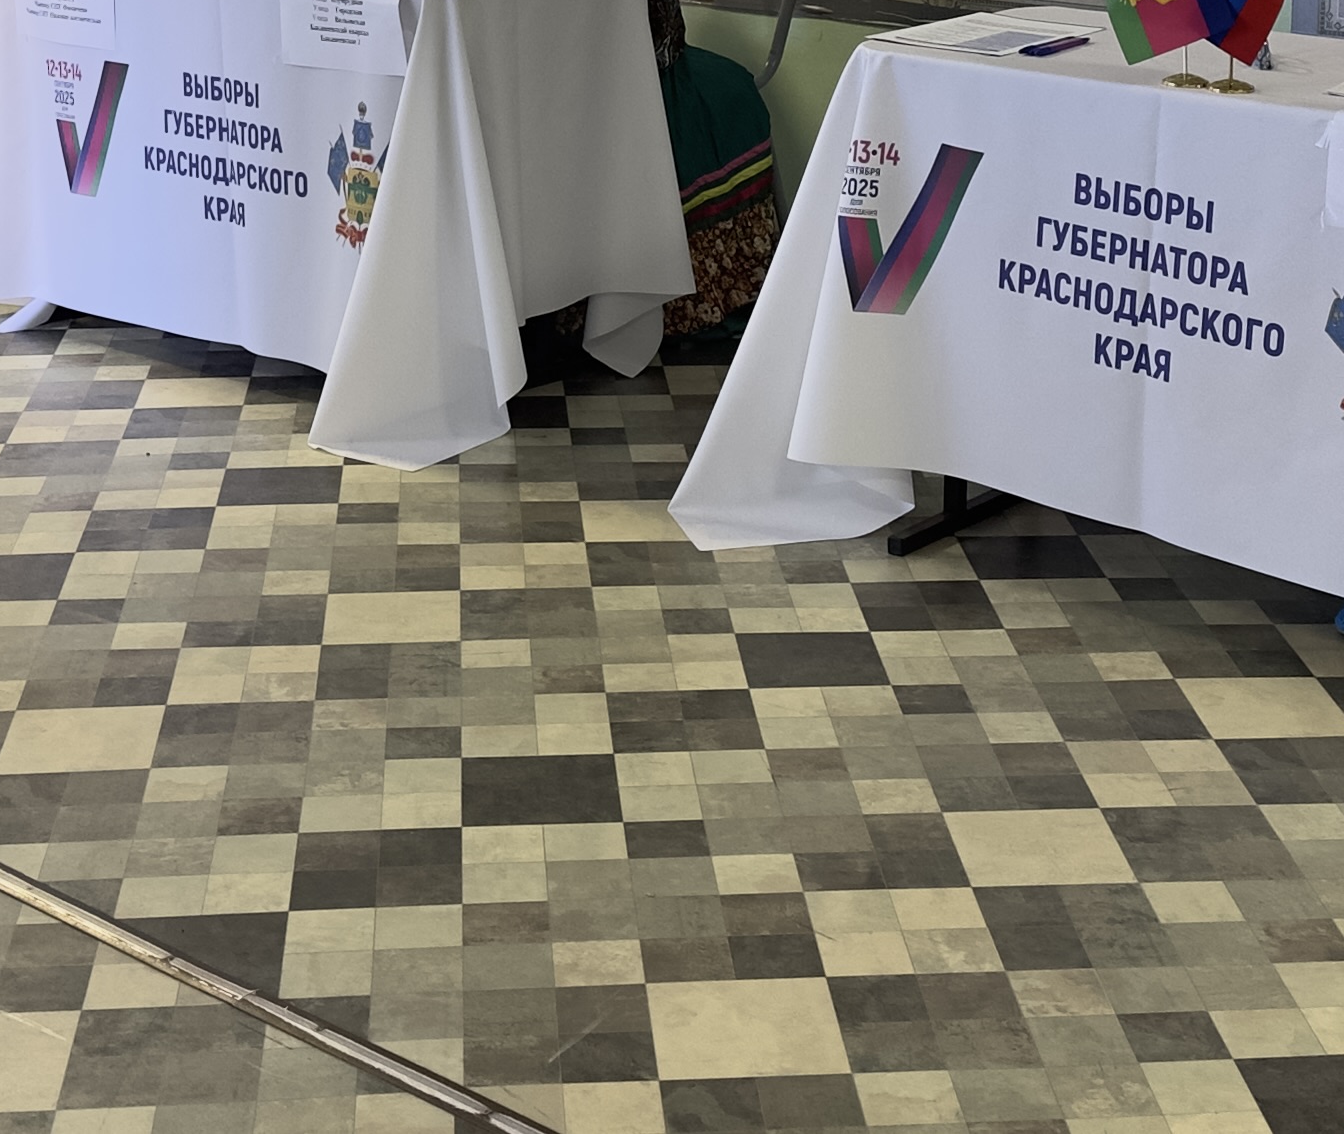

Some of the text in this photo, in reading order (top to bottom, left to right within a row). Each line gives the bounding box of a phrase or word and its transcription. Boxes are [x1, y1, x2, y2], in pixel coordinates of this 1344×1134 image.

[55, 89, 74, 105] 2025
[183, 72, 259, 109] ВЫБОРЫ
[164, 109, 283, 154] ГУБЕРНАТОРА
[144, 146, 308, 198] КРАСНОДАРСКОГО
[842, 178, 879, 198] 2025
[204, 195, 246, 227] КРАЯ
[1074, 172, 1214, 235] ВЫБОРЫ
[1037, 216, 1249, 297] ГУБЕРНАТОРА
[998, 258, 1286, 358] КРАСНОДАРСКОГО
[1094, 333, 1172, 383] КРАЯ
